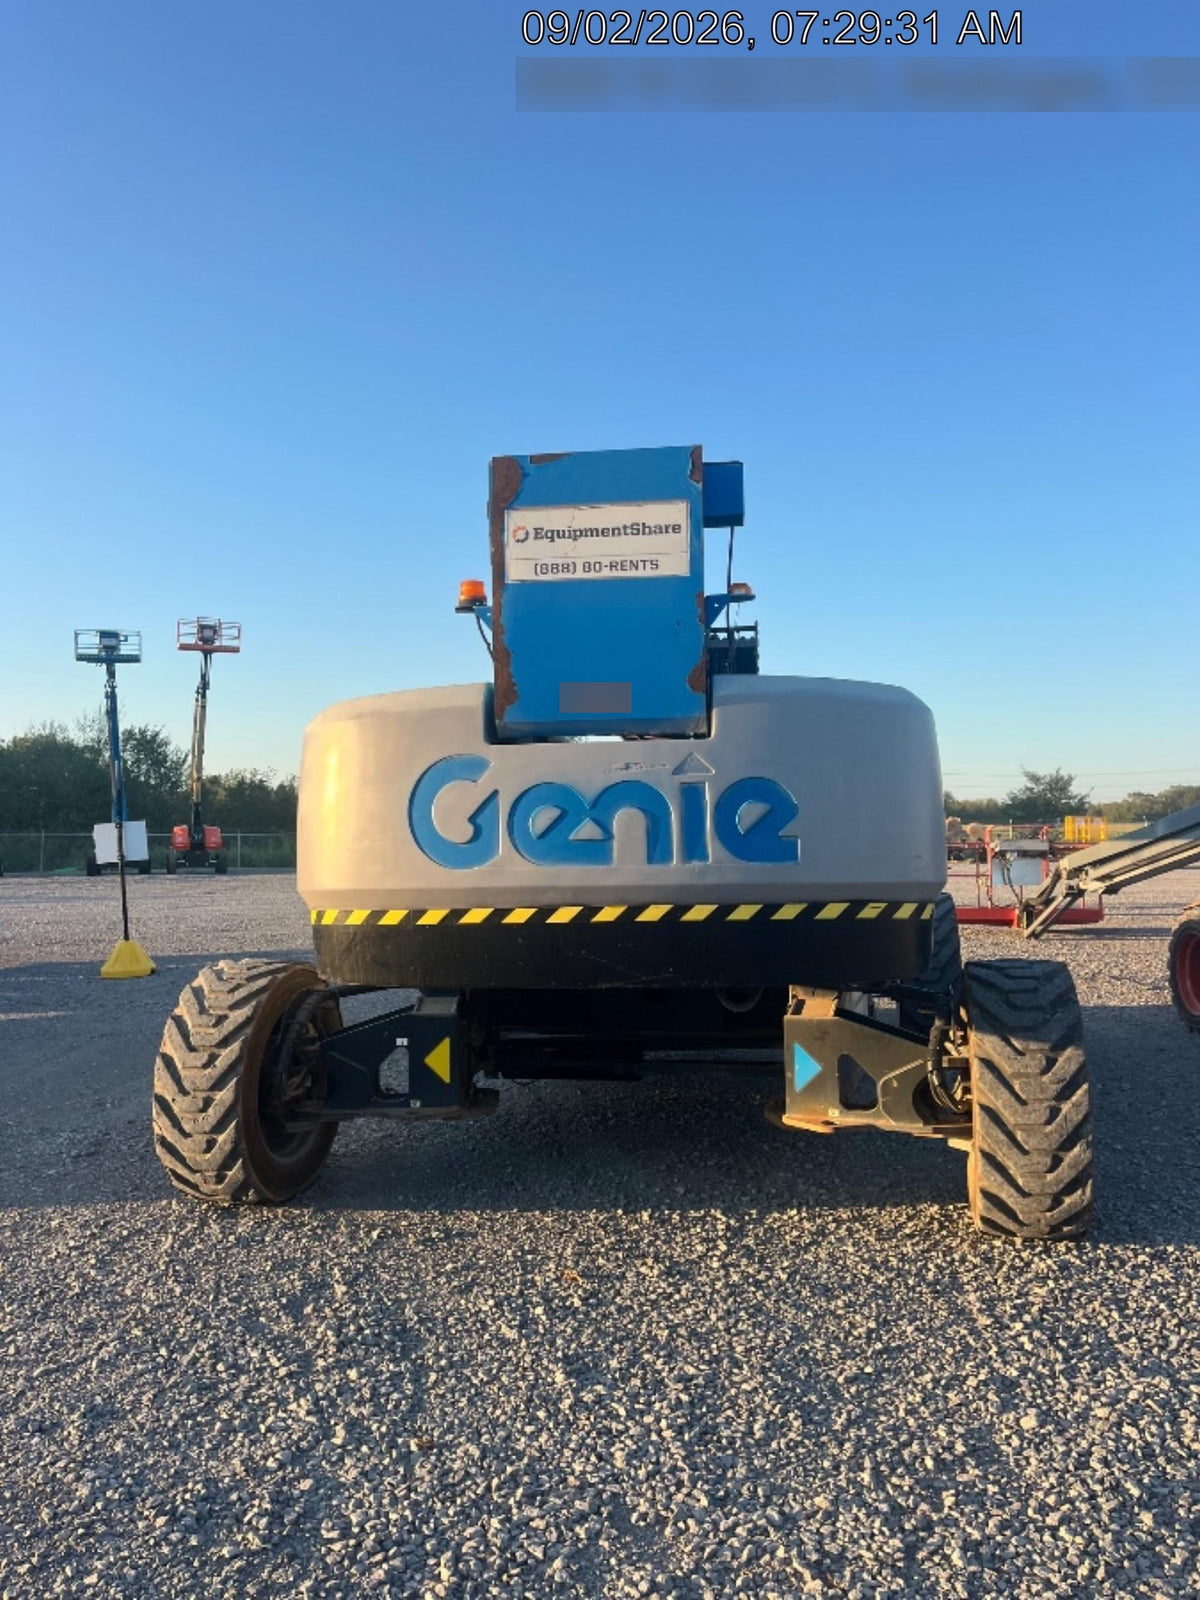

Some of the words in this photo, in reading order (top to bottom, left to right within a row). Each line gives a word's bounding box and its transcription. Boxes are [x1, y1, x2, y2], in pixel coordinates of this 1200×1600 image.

[533, 522, 682, 542] EquipmentShare
[534, 561, 577, 576] (888)
[408, 752, 801, 870] Genie
